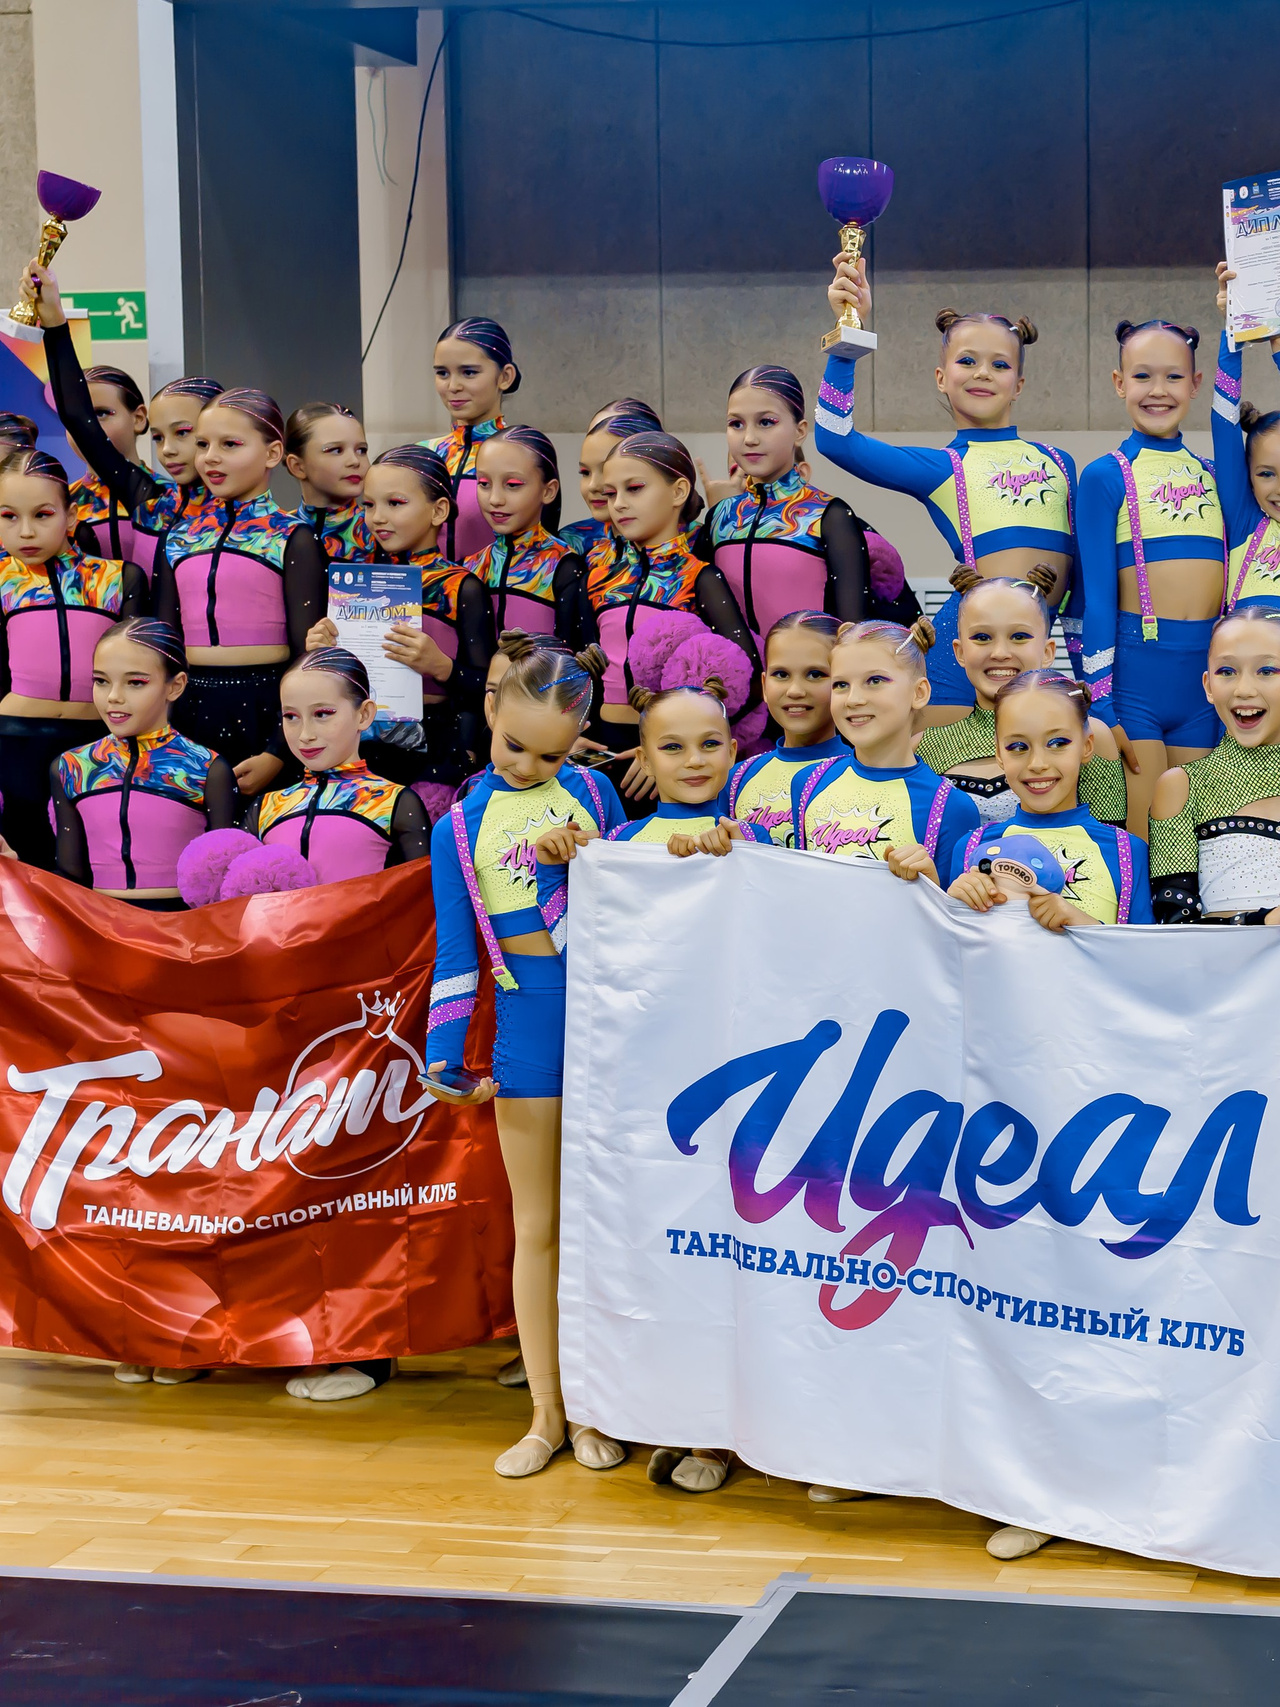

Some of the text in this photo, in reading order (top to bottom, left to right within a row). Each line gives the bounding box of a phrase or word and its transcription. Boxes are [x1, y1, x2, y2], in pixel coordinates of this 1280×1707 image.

[988, 469, 1049, 497] Идеал
[1150, 481, 1208, 511] Идеал
[336, 605, 407, 621] ДИПЛОМ
[811, 821, 878, 855] Идеал
[998, 863, 1031, 883] TOTORO
[666, 1008, 1268, 1332] Идеал
[83, 1182, 457, 1235] ТАНЦЕВАЛЬНО-СПОРТИВНЫЙ КЛУБ
[666, 1229, 1246, 1358] ТАНЦЕВАЛЬНО-СПОРТИВНЫЙ КЛУБ
